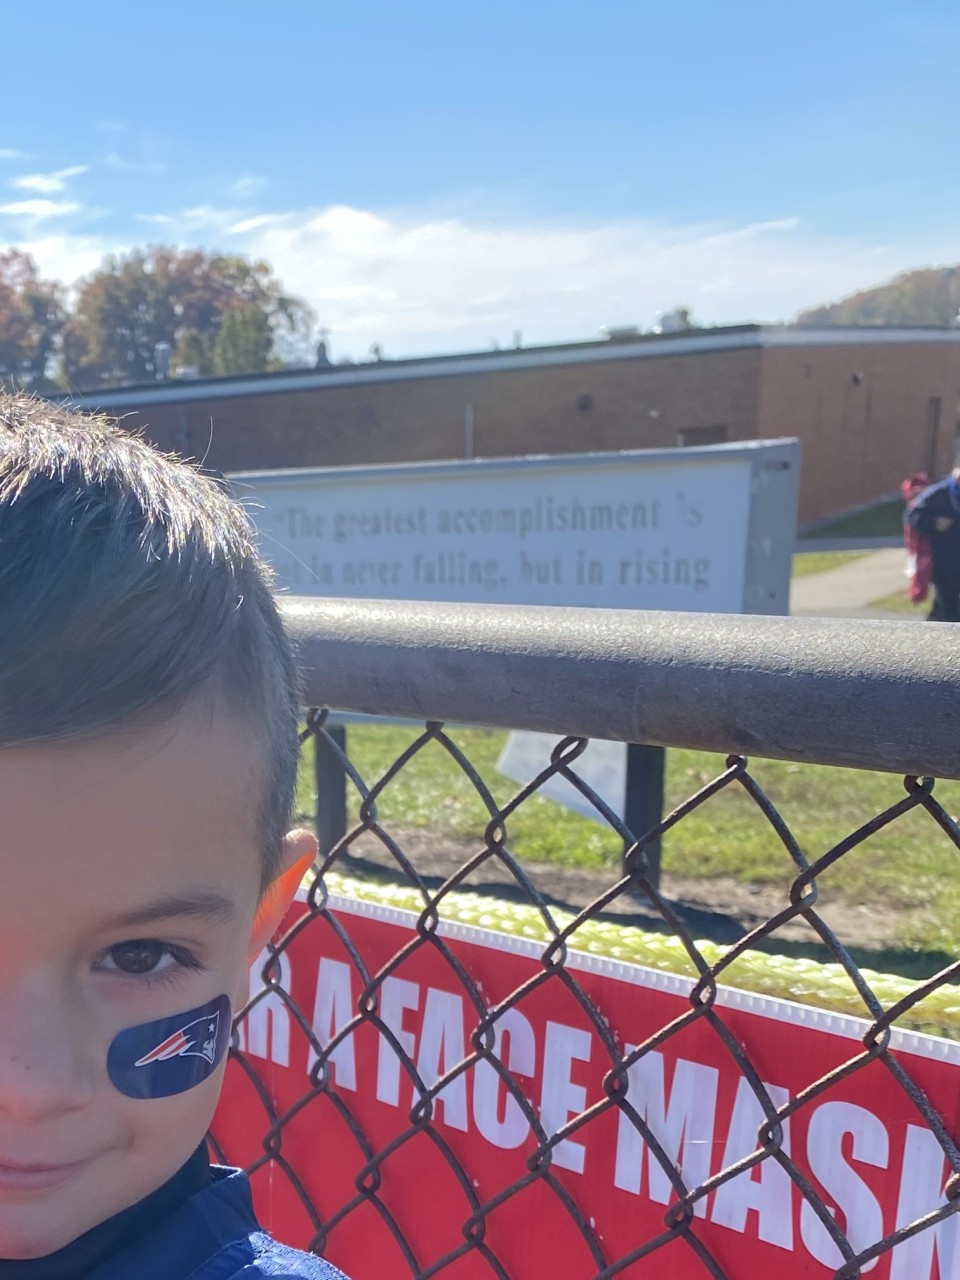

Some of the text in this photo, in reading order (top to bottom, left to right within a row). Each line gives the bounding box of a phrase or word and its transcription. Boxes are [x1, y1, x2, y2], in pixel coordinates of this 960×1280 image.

[333, 506, 426, 543] greatest
[438, 494, 662, 541] accomplishment
[343, 560, 402, 586] never
[413, 551, 508, 591] falling,
[520, 550, 562, 586] but
[576, 548, 605, 586] in
[618, 547, 711, 592] rising
[307, 957, 357, 1092] A
[376, 976, 593, 1175] FACE
